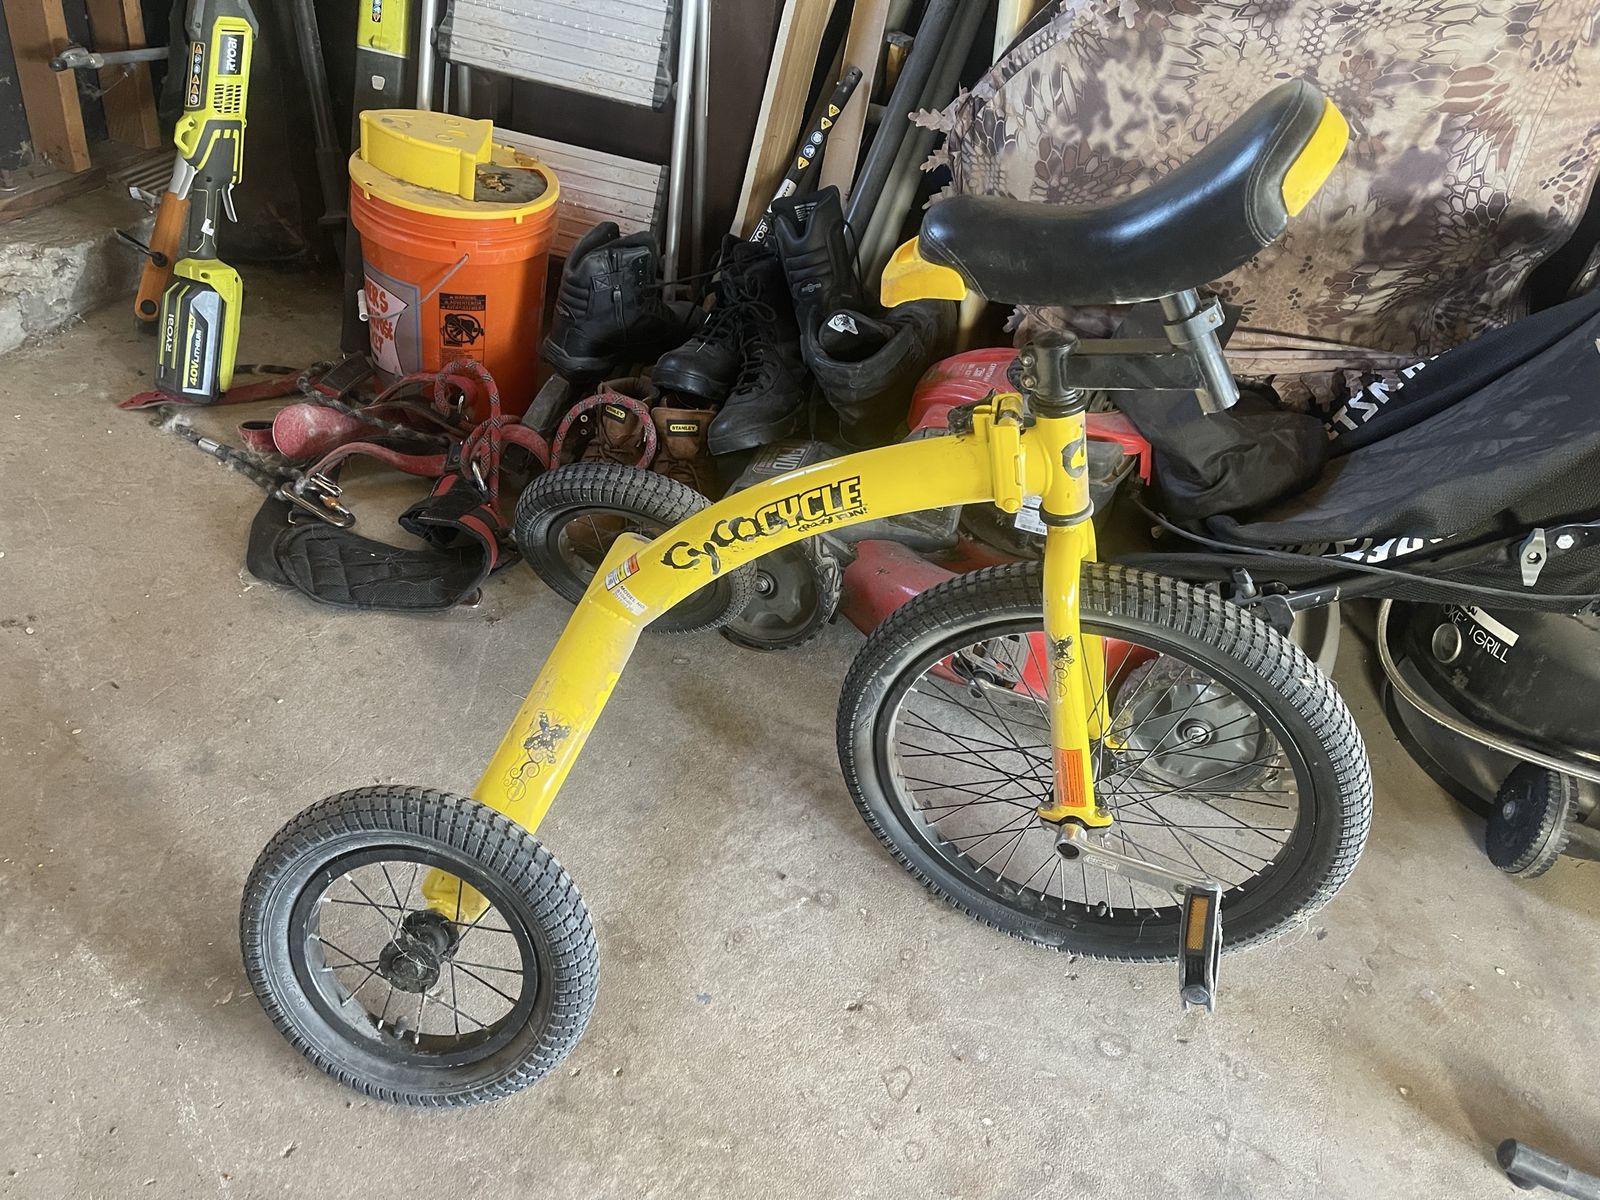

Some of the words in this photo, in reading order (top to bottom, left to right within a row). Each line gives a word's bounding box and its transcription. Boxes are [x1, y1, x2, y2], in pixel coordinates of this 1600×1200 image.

[226, 36, 238, 71] RYOBI
[165, 313, 175, 352] RYOBI
[1473, 630, 1507, 664] GRILL
